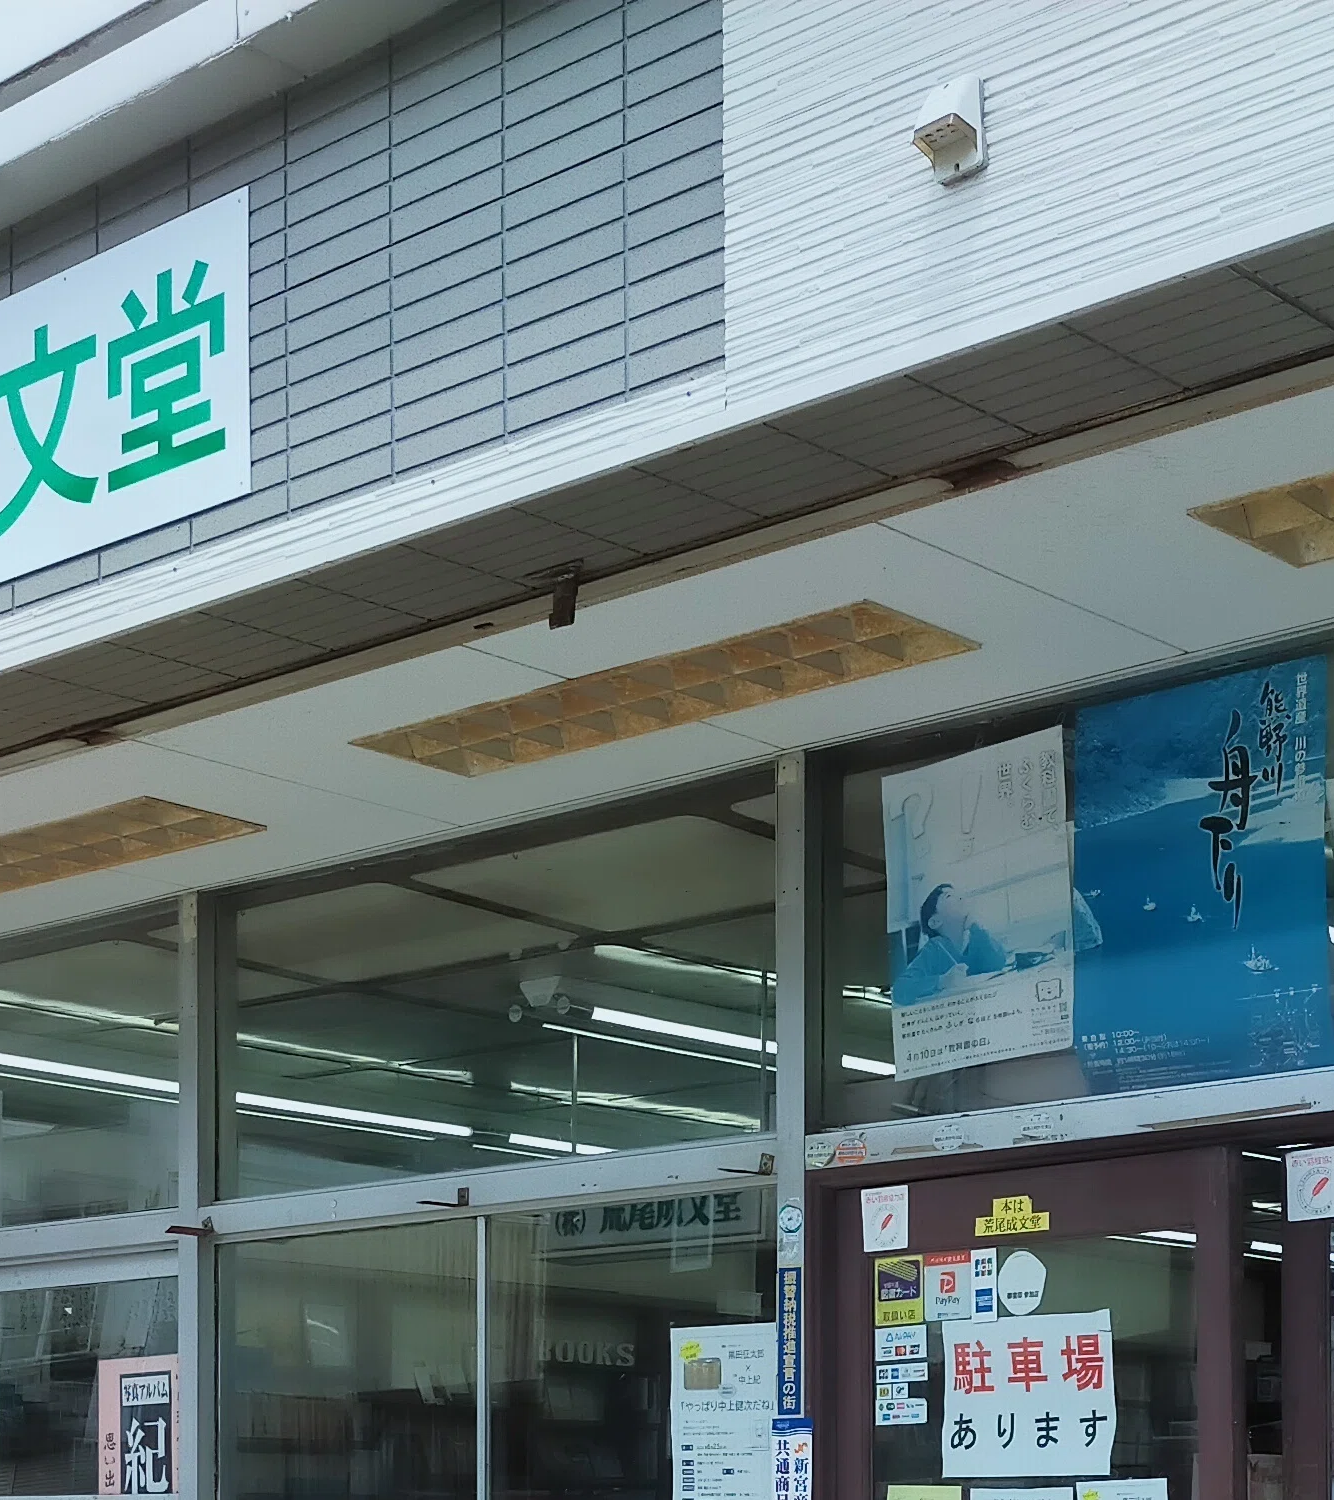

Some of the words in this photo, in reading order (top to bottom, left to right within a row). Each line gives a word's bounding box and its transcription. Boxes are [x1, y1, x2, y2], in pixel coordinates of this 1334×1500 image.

[1258, 680, 1291, 796] 熊野川
[1197, 708, 1259, 930] 舟下り
[1000, 1199, 1025, 1213] 本は
[982, 1214, 1043, 1233] 荒尾成文堂
[935, 1296, 961, 1305] PayPay
[953, 1336, 1105, 1395] 駐車場
[123, 1380, 169, 1403] 写真アルバム
[680, 1400, 774, 1413] 「やっぱり中上健次だね」
[950, 1409, 1108, 1450] あります
